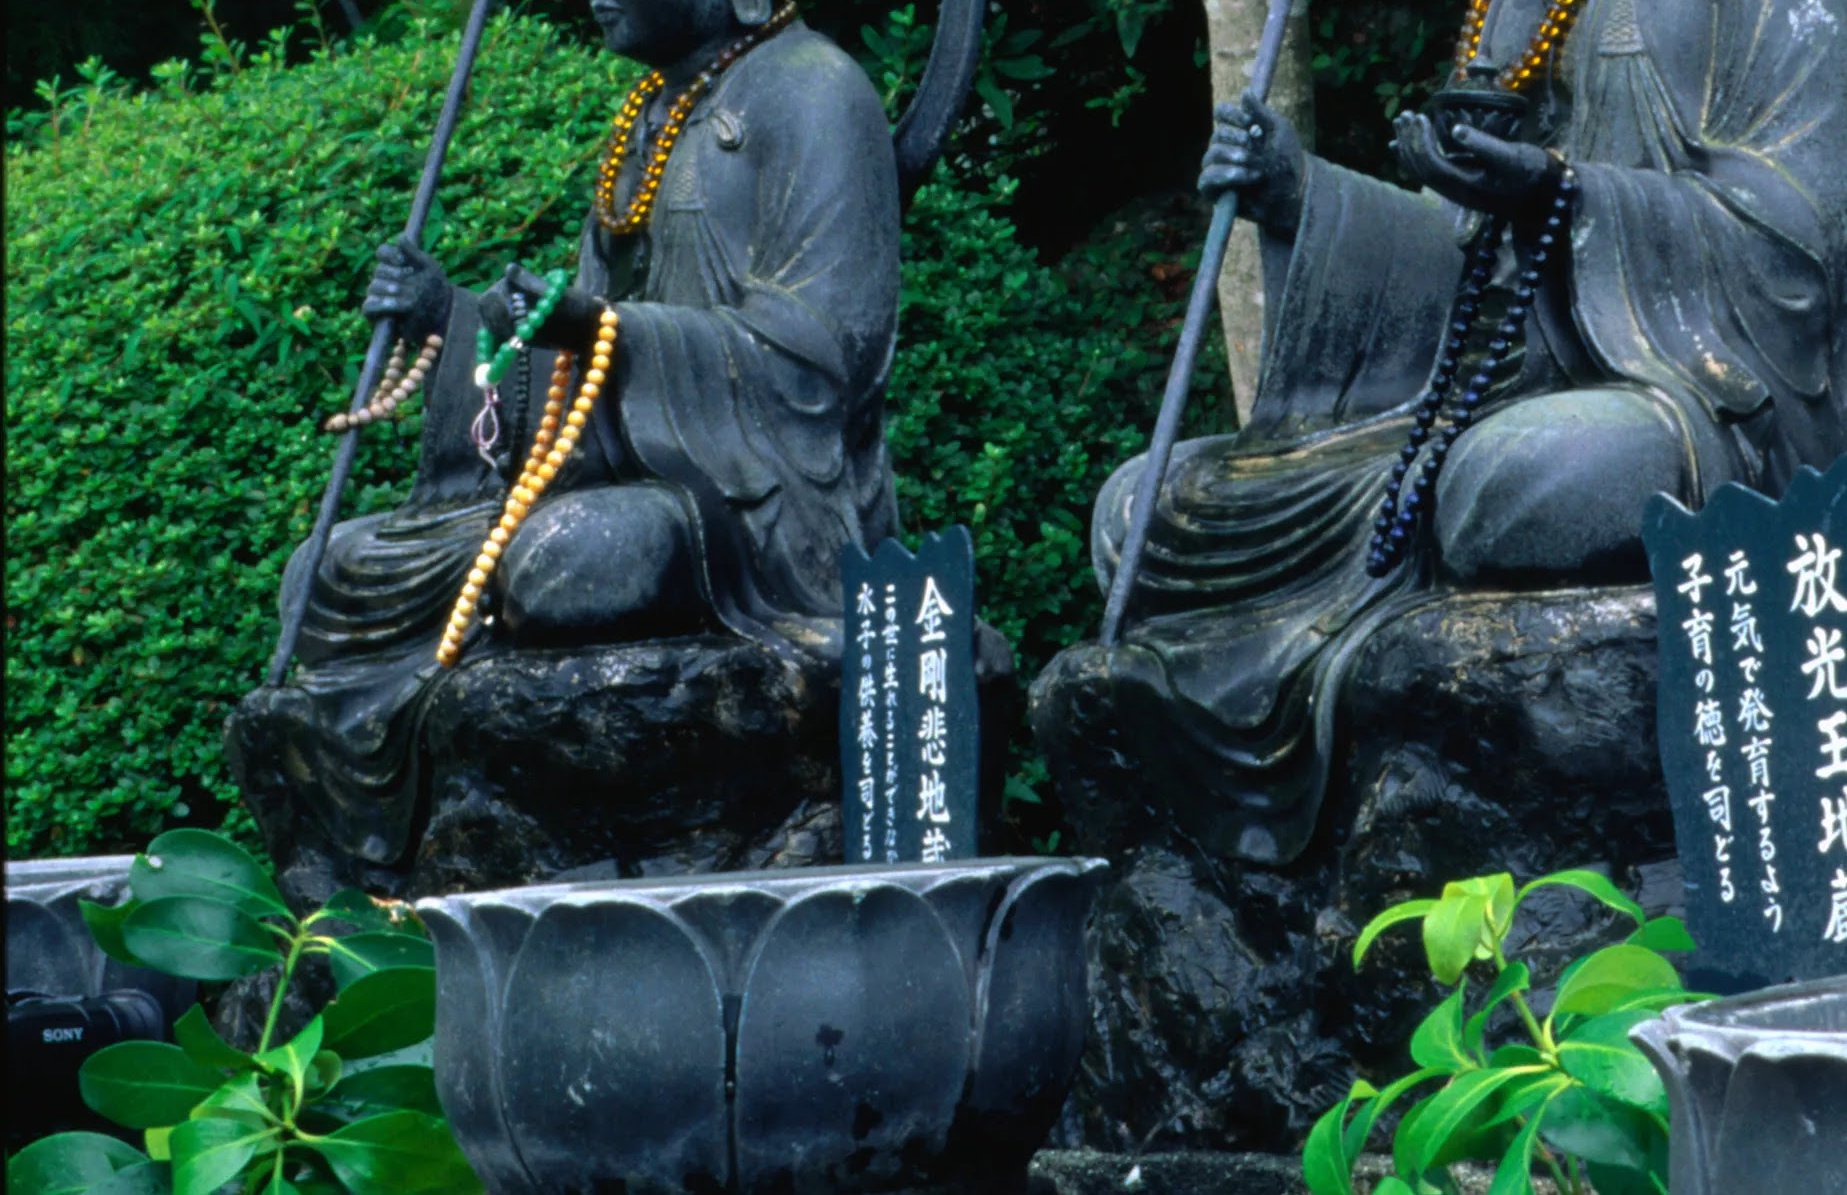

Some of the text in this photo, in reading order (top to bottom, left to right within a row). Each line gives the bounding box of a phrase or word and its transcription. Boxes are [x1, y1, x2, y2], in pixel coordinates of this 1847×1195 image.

[856, 581, 878, 861] 水子の供養を司どる
[1674, 551, 1736, 904] 子育の徳を司どる
[1721, 549, 1784, 934] 元気で発育するよう
[42, 1027, 84, 1043] SONY
